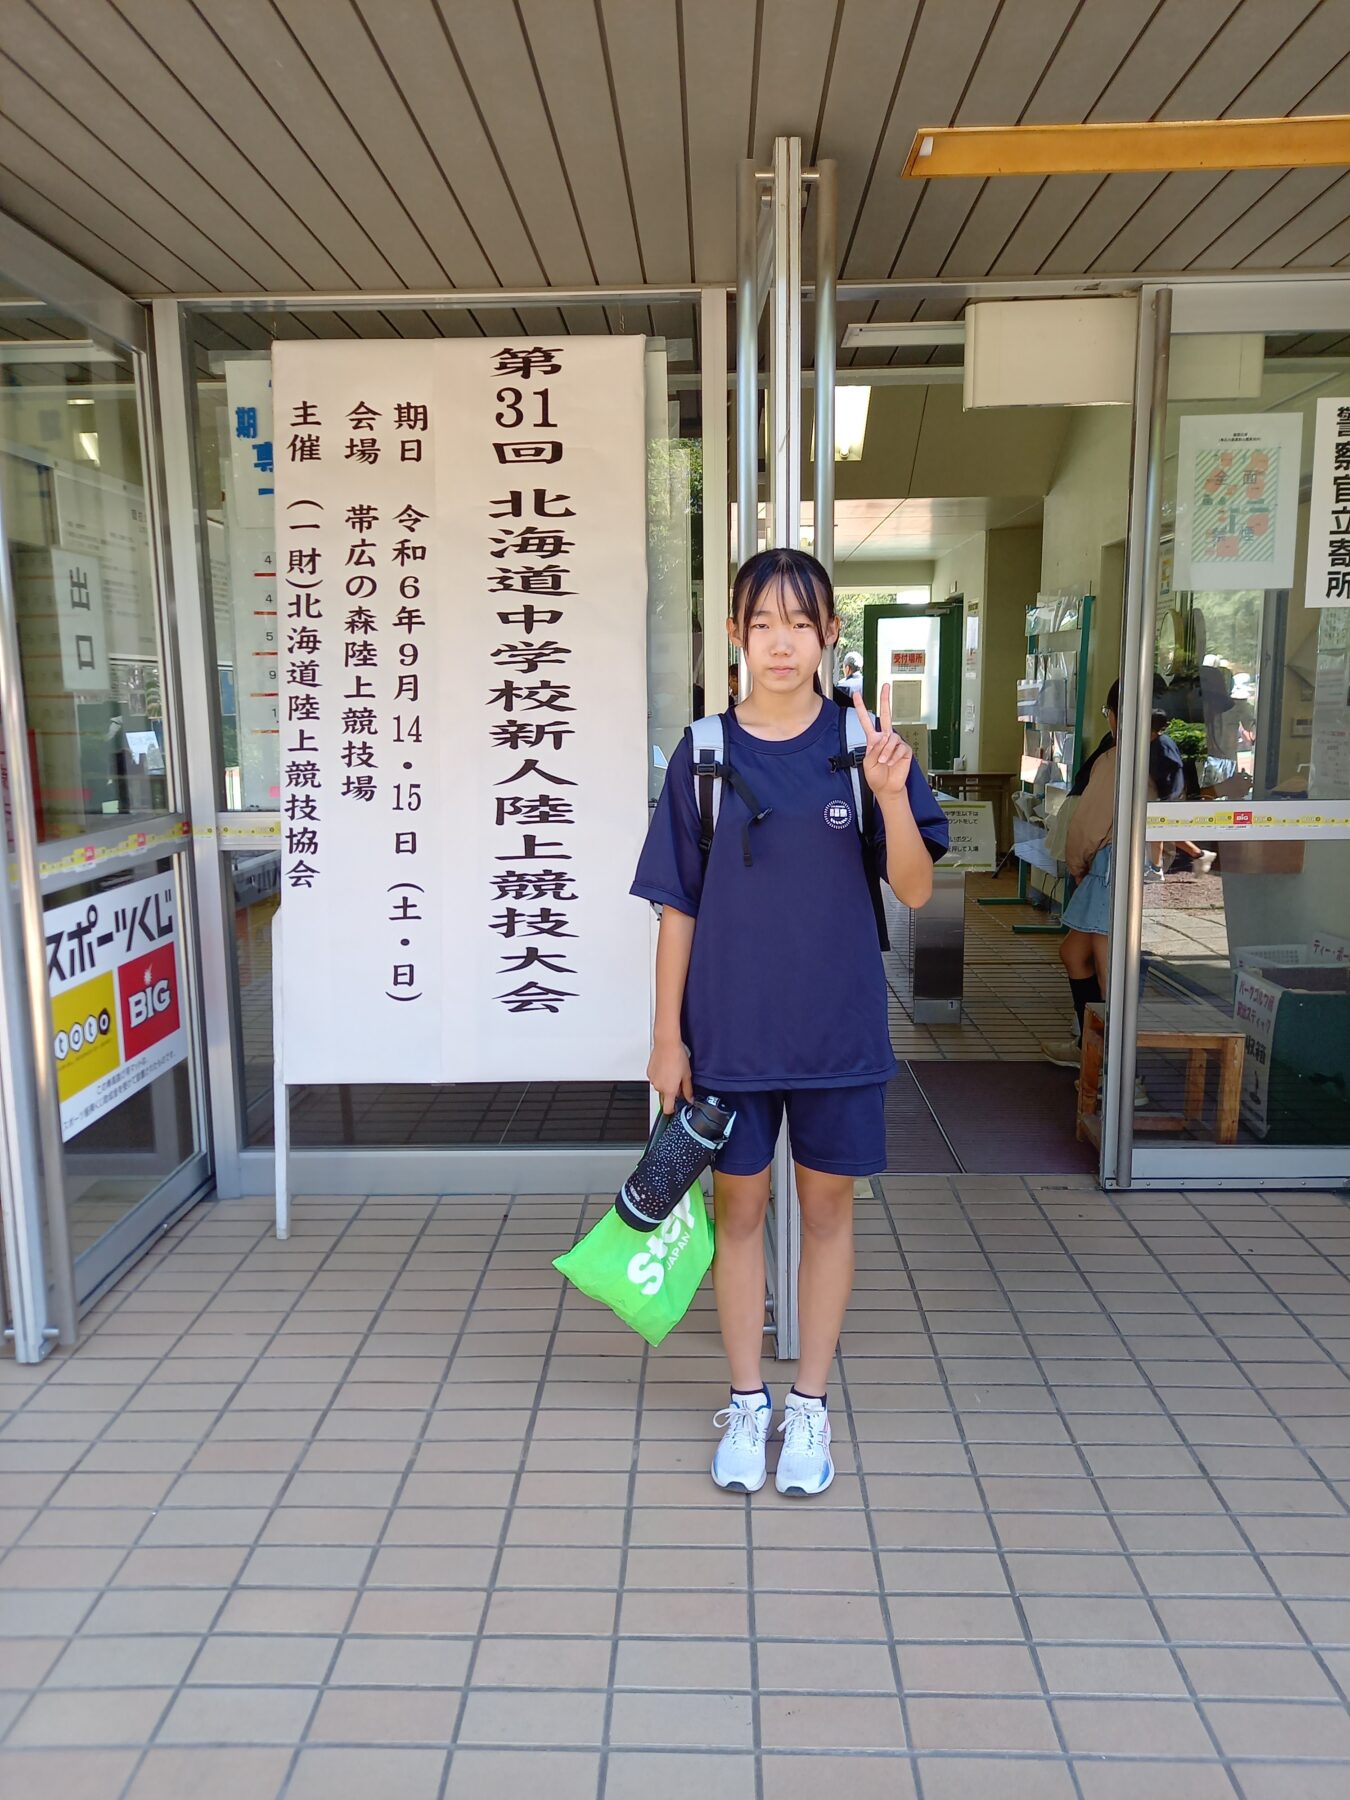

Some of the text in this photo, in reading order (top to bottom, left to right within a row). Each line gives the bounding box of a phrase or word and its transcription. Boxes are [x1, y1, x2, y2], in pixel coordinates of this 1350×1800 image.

[286, 400, 322, 462] 主催
[393, 402, 429, 463] 期日
[341, 400, 382, 802] 会場 帯広の森陸上競技場
[485, 347, 580, 1013] 第31回 北海道中学校新人陸上競技大会
[47, 889, 173, 981] スポーツくじ
[128, 979, 171, 1028] BIG
[55, 1009, 110, 1060] toto
[666, 1231, 692, 1271] JAPAN
